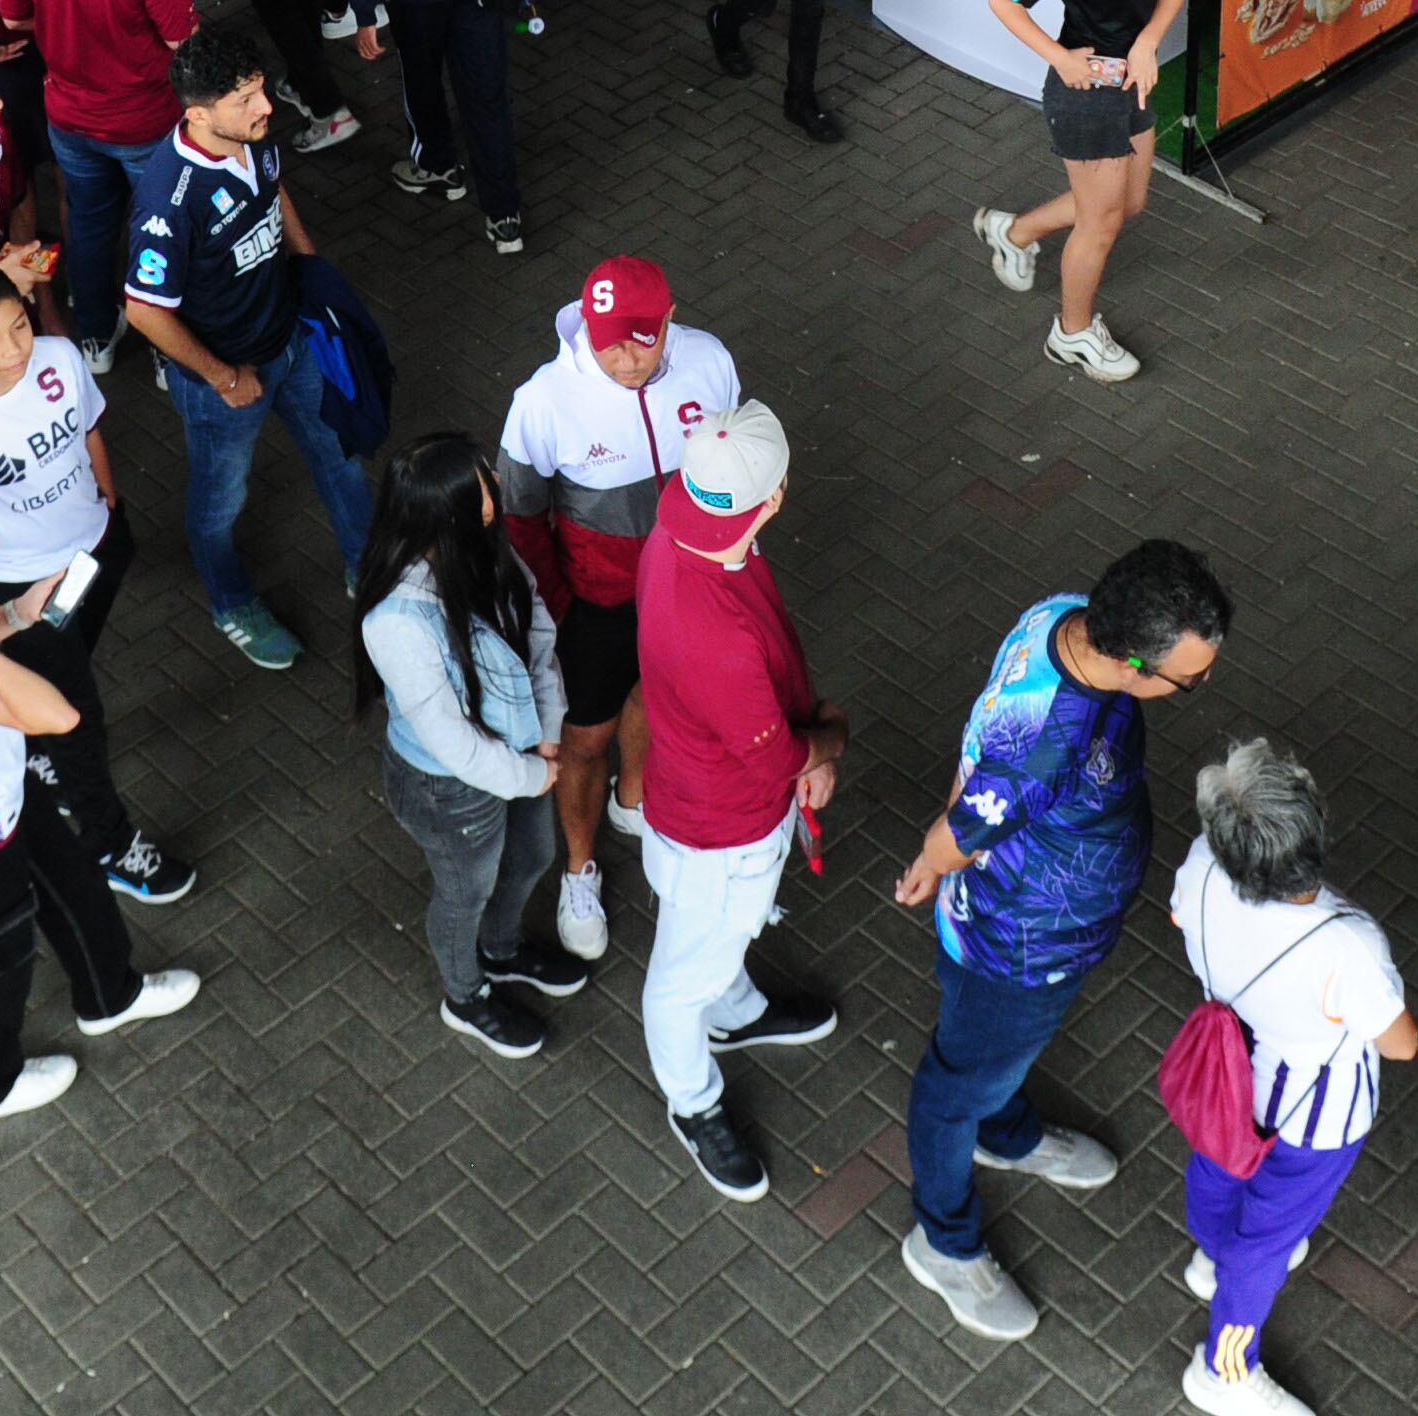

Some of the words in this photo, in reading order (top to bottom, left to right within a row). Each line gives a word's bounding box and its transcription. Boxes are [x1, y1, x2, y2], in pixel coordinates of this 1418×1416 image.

[171, 165, 193, 206] Kappa
[222, 200, 249, 227] TOYOTA
[136, 247, 168, 286] S
[592, 279, 615, 314] S
[37, 366, 65, 404] S
[27, 406, 80, 460] BAC
[590, 452, 628, 469] TOYOTA
[10, 462, 86, 515] LIBERTY
